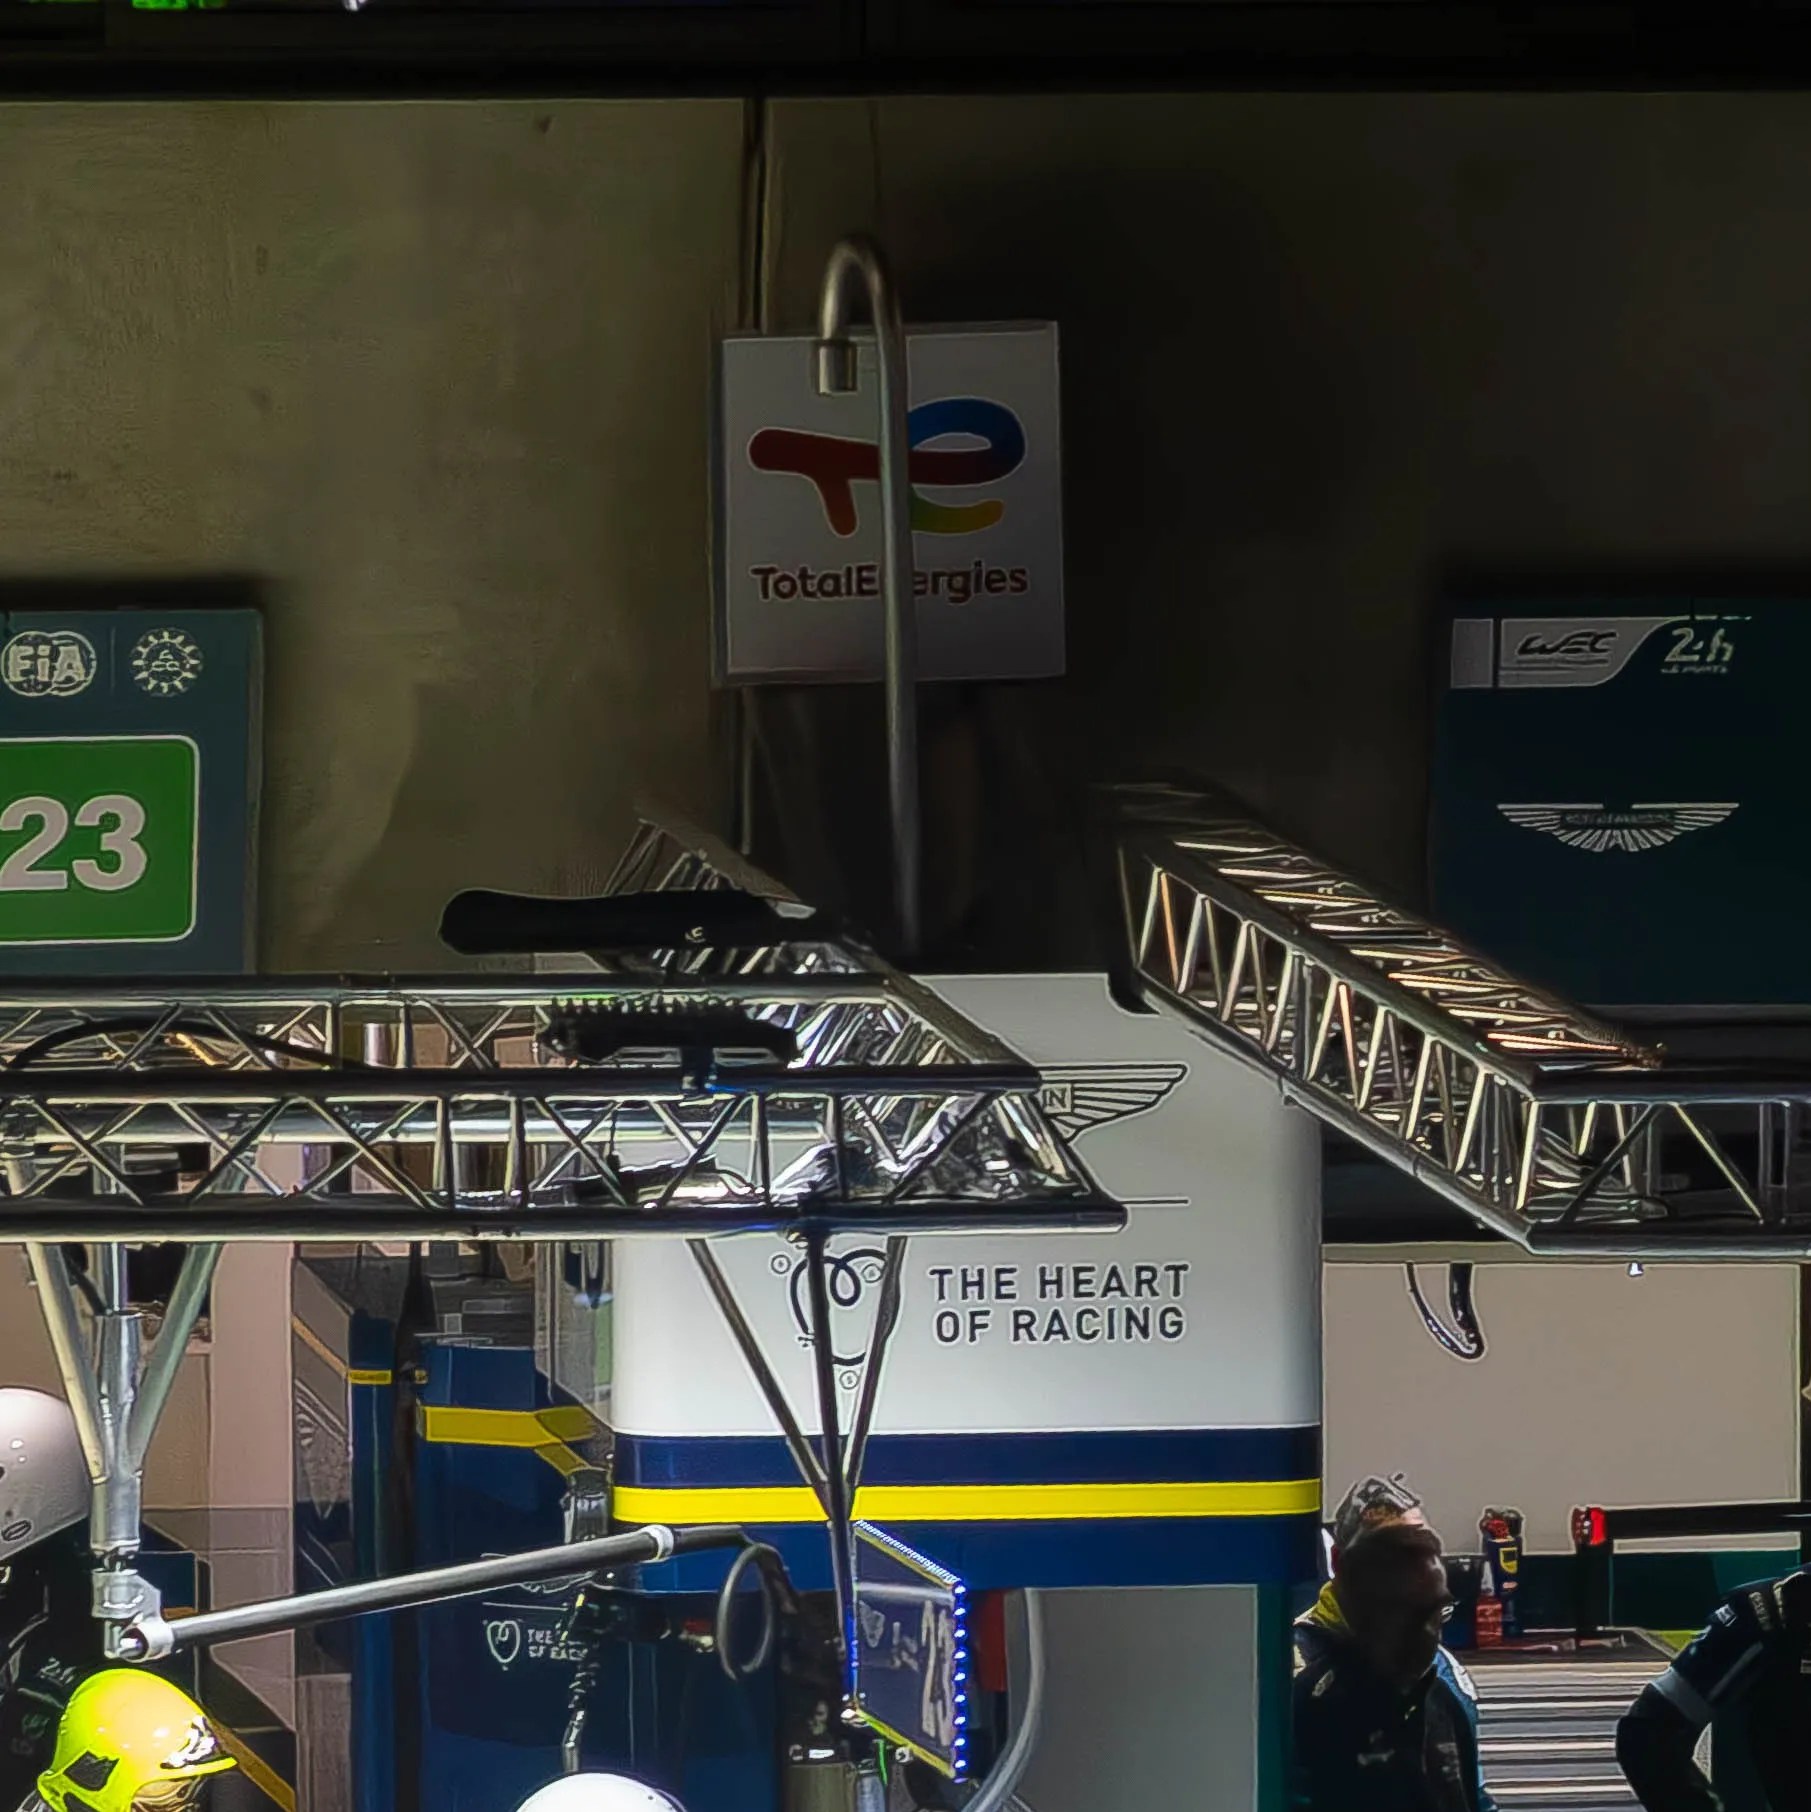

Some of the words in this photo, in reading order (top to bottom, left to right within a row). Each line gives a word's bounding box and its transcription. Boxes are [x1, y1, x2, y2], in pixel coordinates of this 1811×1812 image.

[750, 560, 1029, 605] TotalEergies
[0, 795, 147, 891] 23
[929, 1266, 1019, 1301] THE
[1038, 1263, 1189, 1299] HEART
[935, 1309, 991, 1343] OF
[1012, 1306, 1185, 1342] RACING
